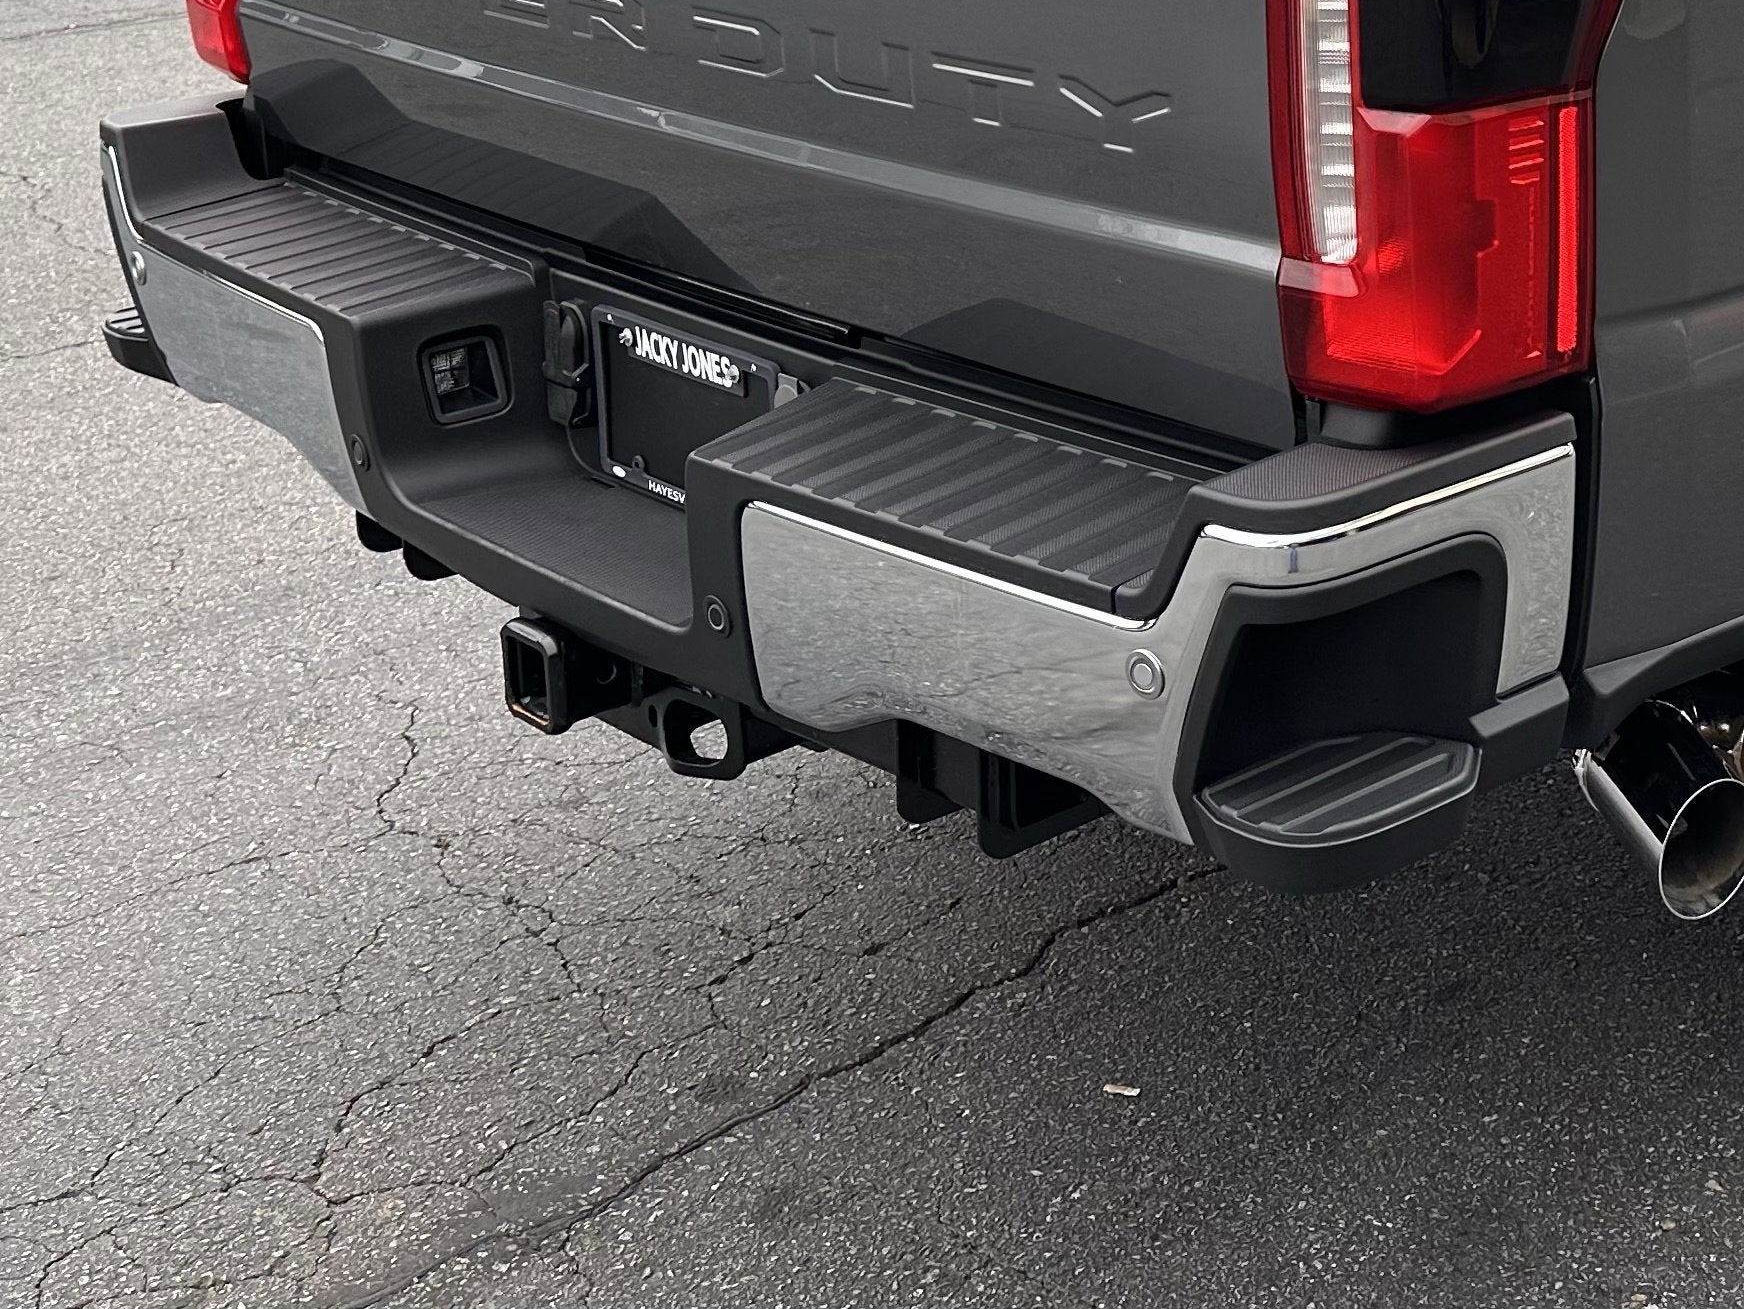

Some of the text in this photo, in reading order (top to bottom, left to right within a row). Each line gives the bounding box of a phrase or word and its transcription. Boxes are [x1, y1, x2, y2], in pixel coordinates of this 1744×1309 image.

[691, 5, 1172, 155] DUTY
[635, 325, 734, 388] JACKY JONES
